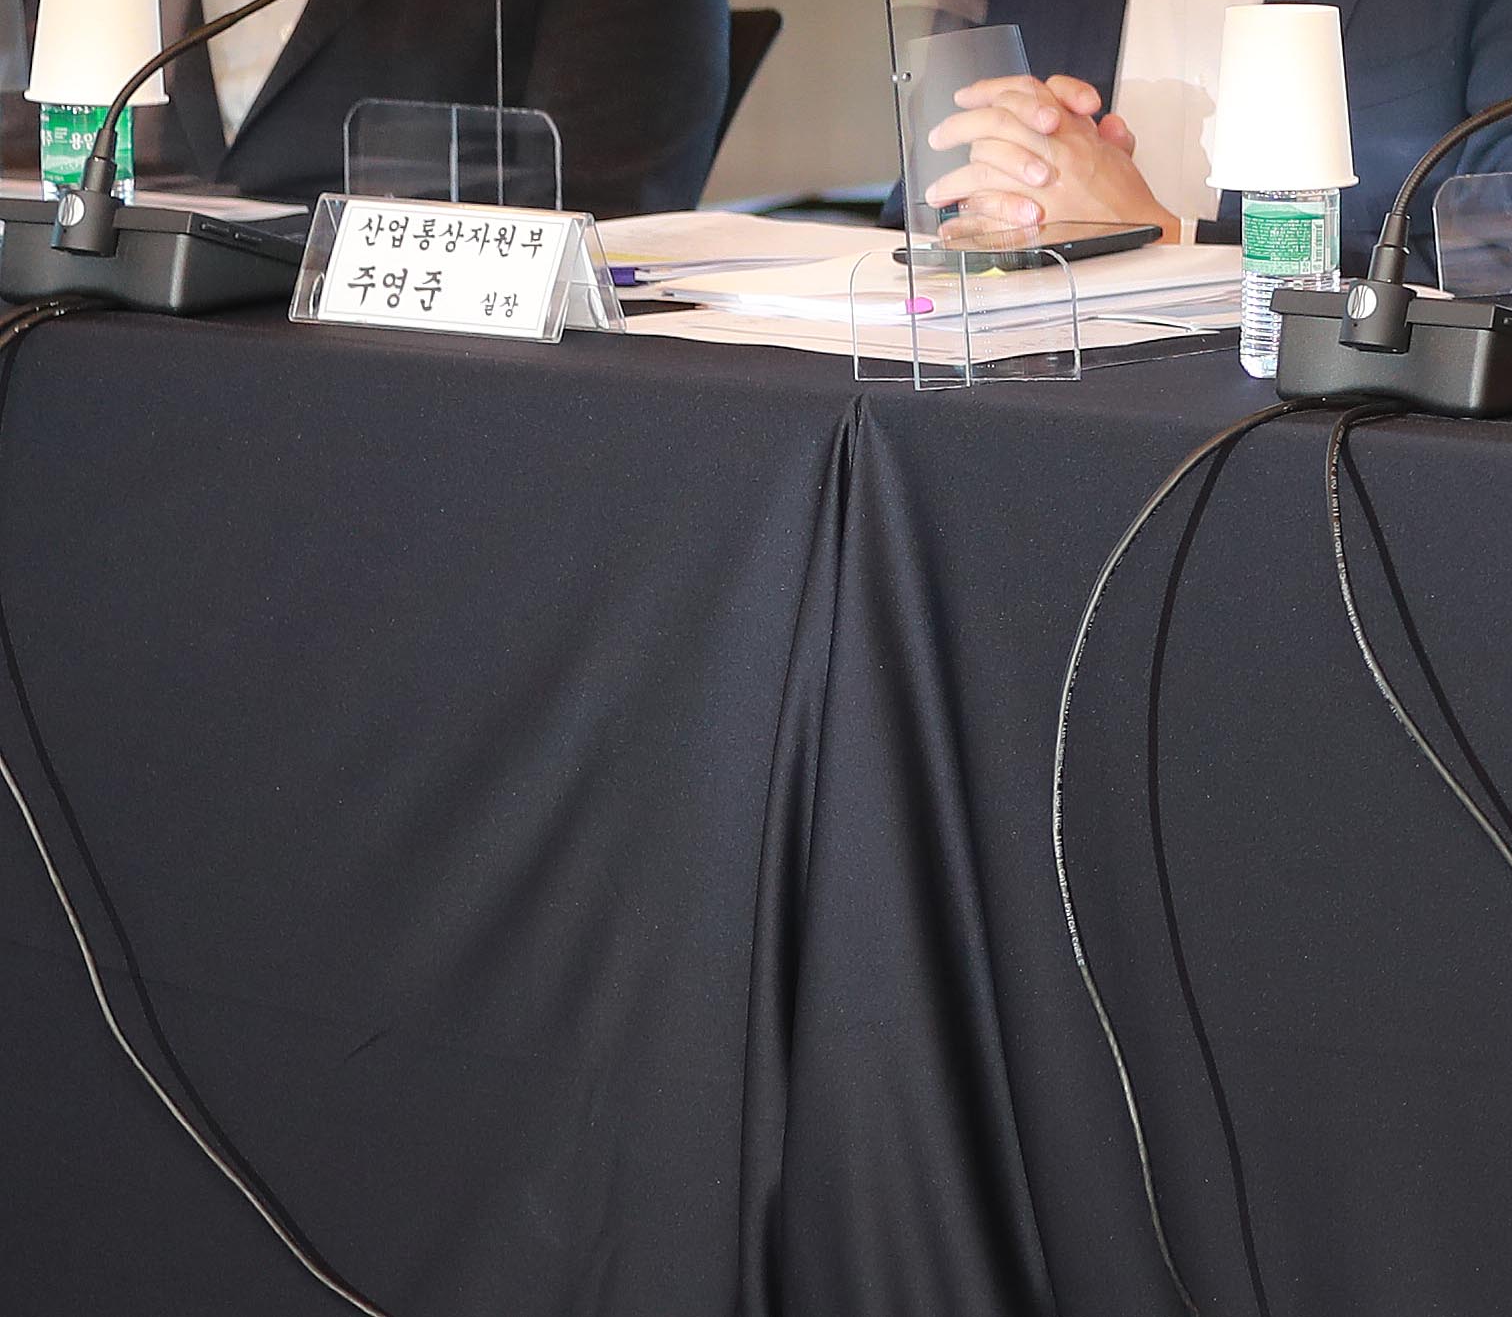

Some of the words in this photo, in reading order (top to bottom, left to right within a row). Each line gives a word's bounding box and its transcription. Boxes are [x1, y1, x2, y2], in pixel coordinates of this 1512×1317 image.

[357, 214, 545, 259] 산업통상자원부
[346, 265, 443, 312] 주영준
[479, 291, 519, 319] 실장
